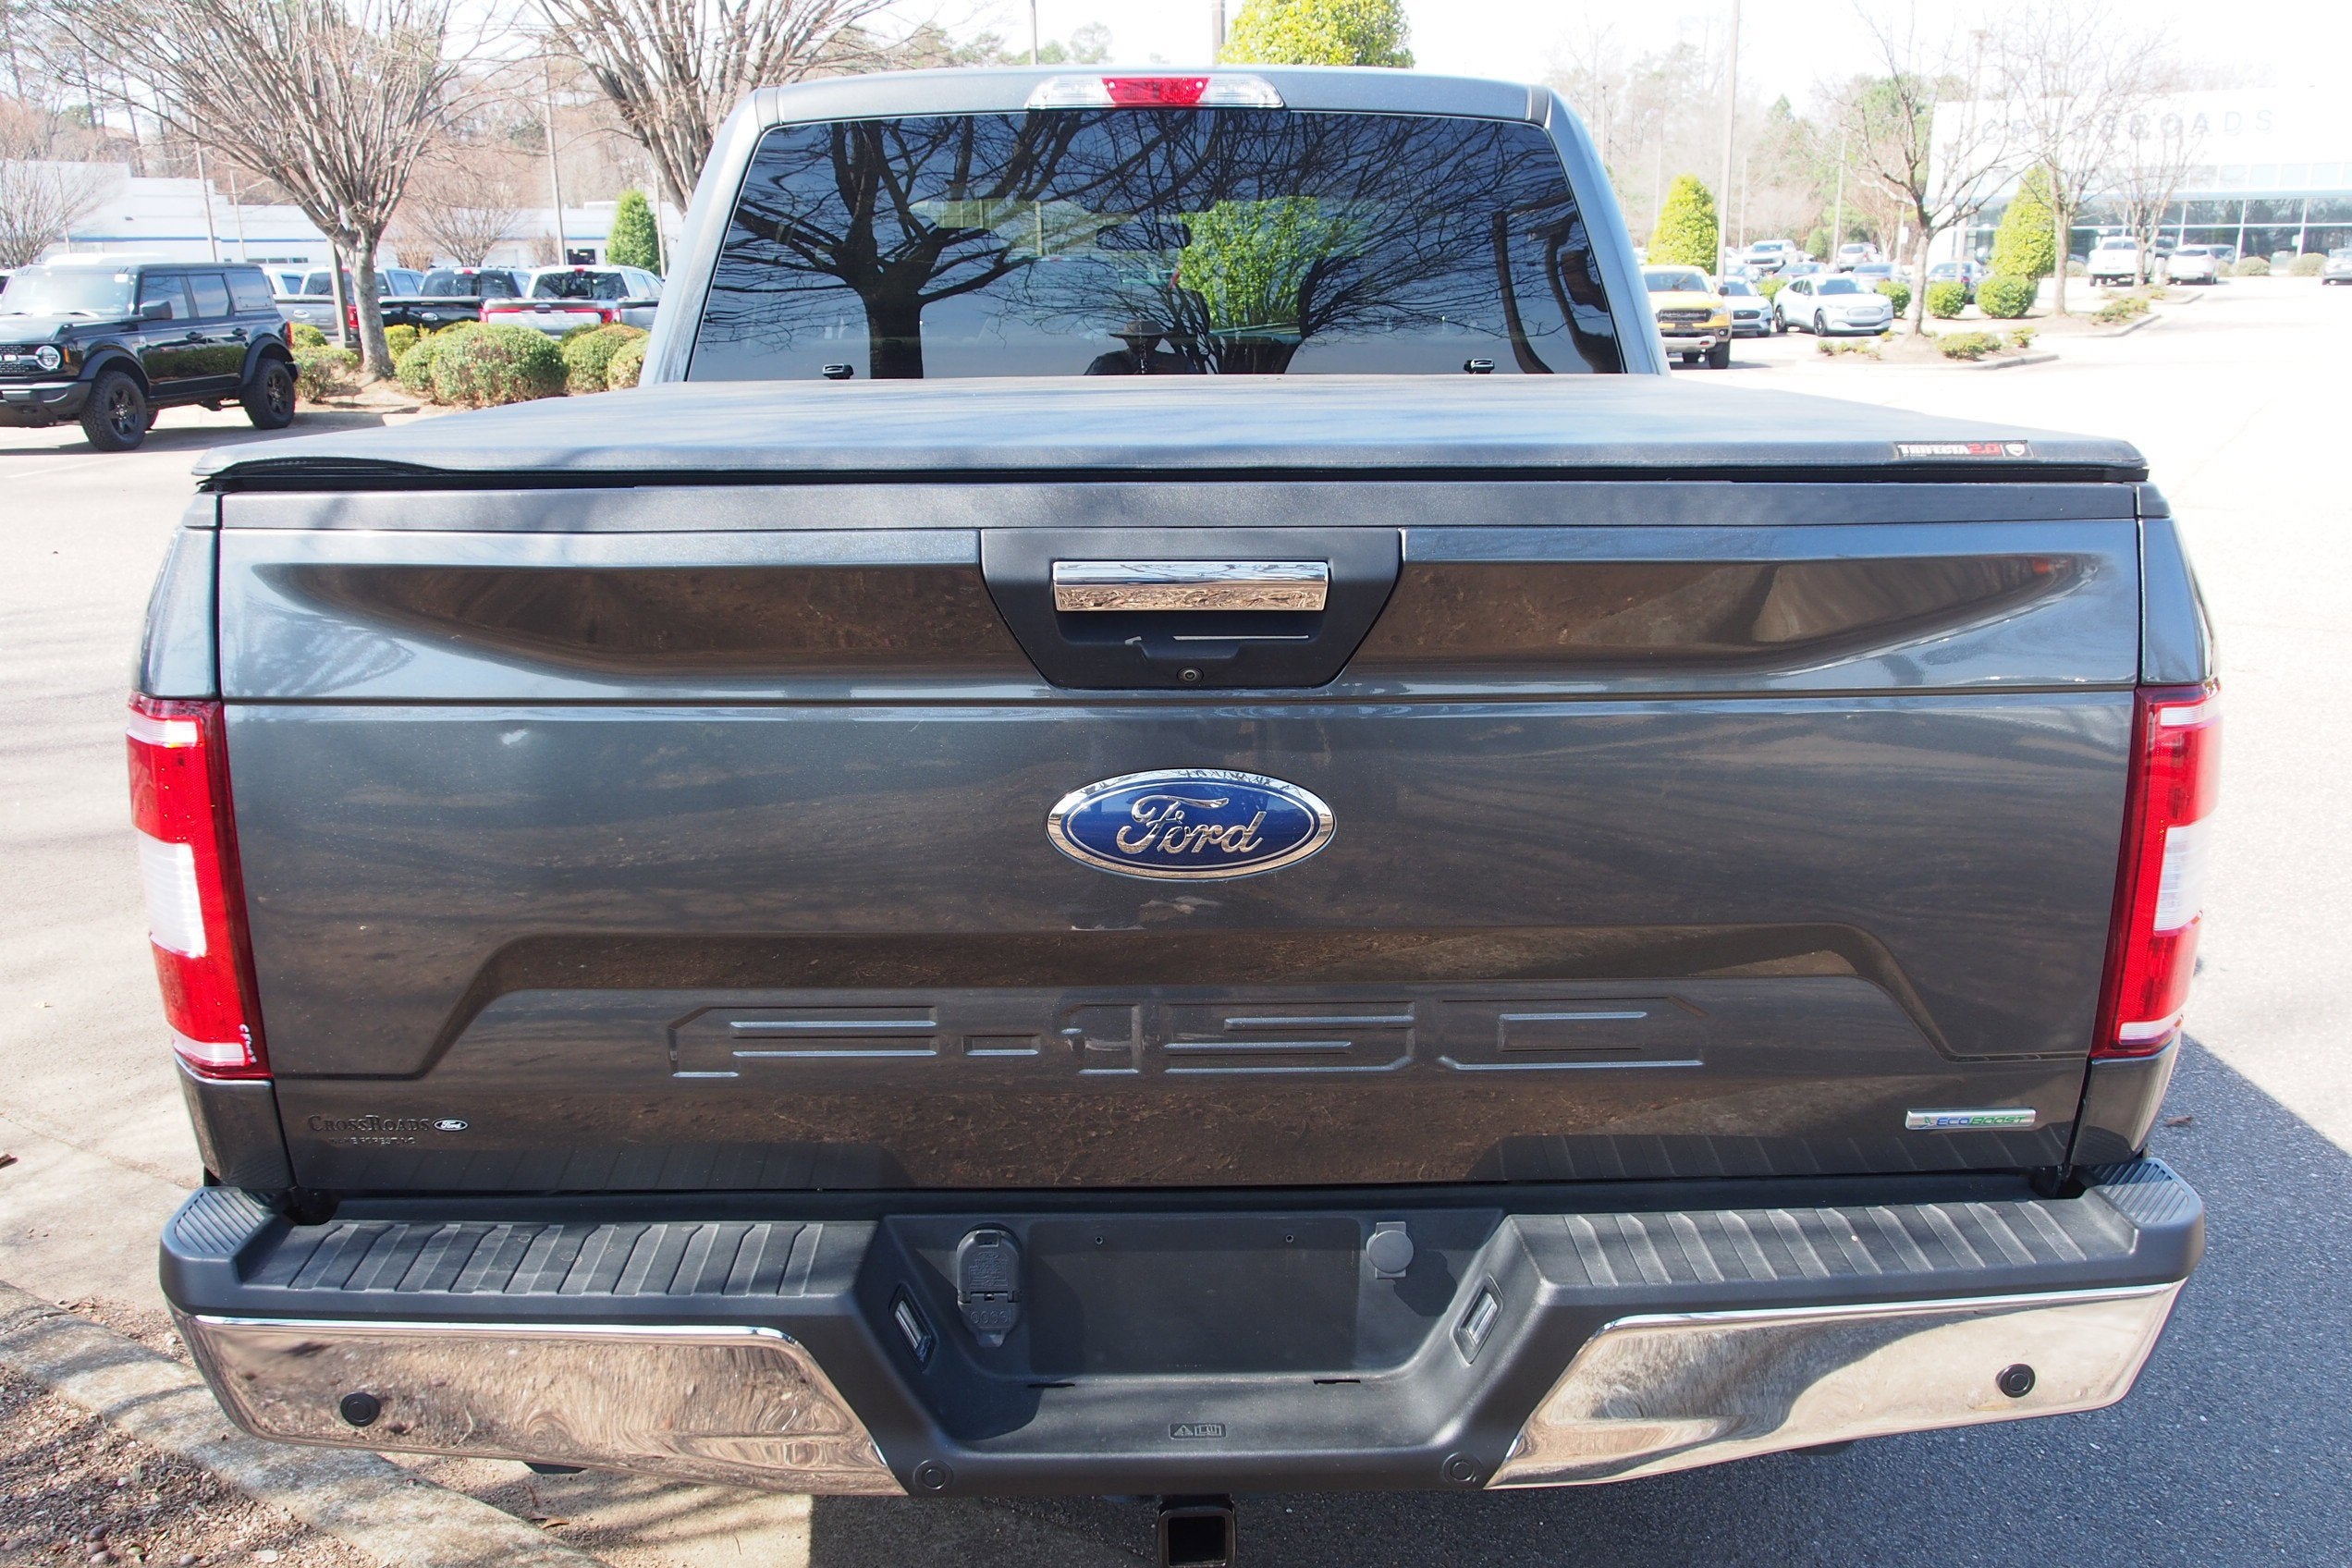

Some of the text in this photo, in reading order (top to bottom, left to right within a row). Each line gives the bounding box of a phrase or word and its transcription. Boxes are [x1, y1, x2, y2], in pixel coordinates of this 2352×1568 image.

[1980, 108, 2274, 140] CRSSROADS
[1966, 443, 2002, 456] 2.0
[1116, 793, 1268, 854] Ford
[667, 997, 1706, 1078] F-150
